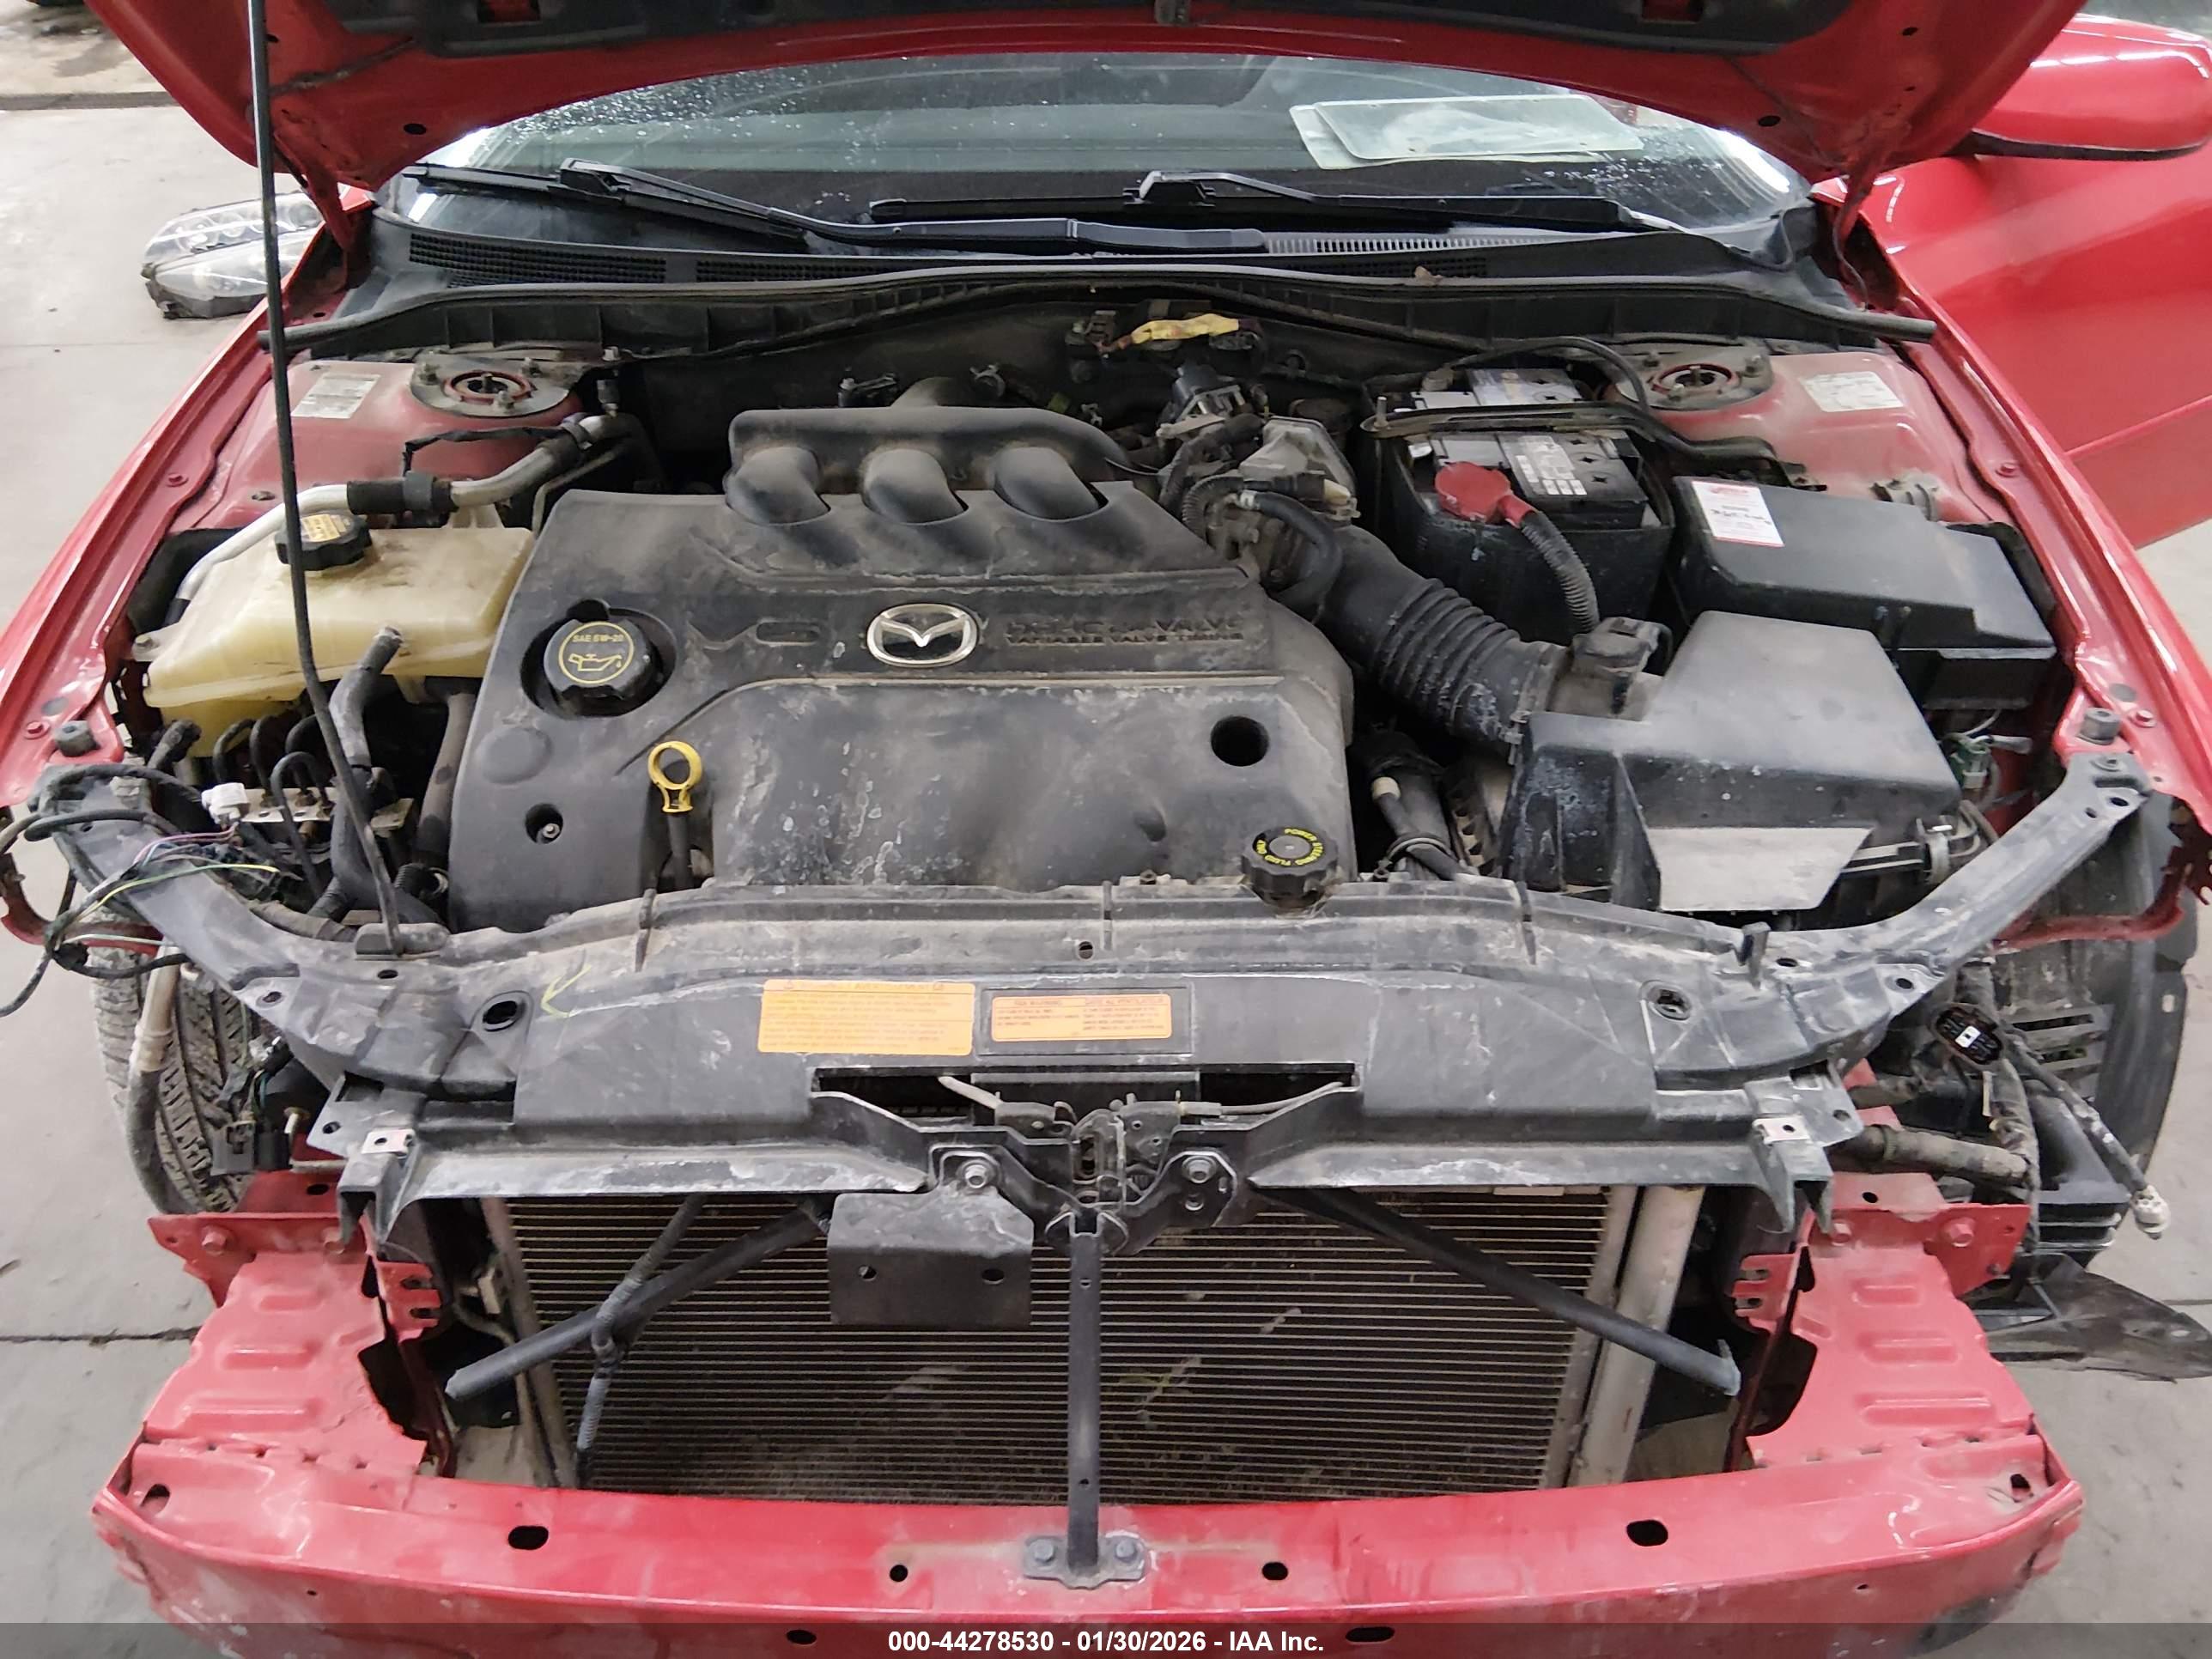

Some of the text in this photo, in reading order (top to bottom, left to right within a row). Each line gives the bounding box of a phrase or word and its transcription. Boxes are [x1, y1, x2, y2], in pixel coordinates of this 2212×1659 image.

[572, 635, 592, 643] SAE
[1256, 828, 1324, 866] POWER STEERING FLUID ONLY
